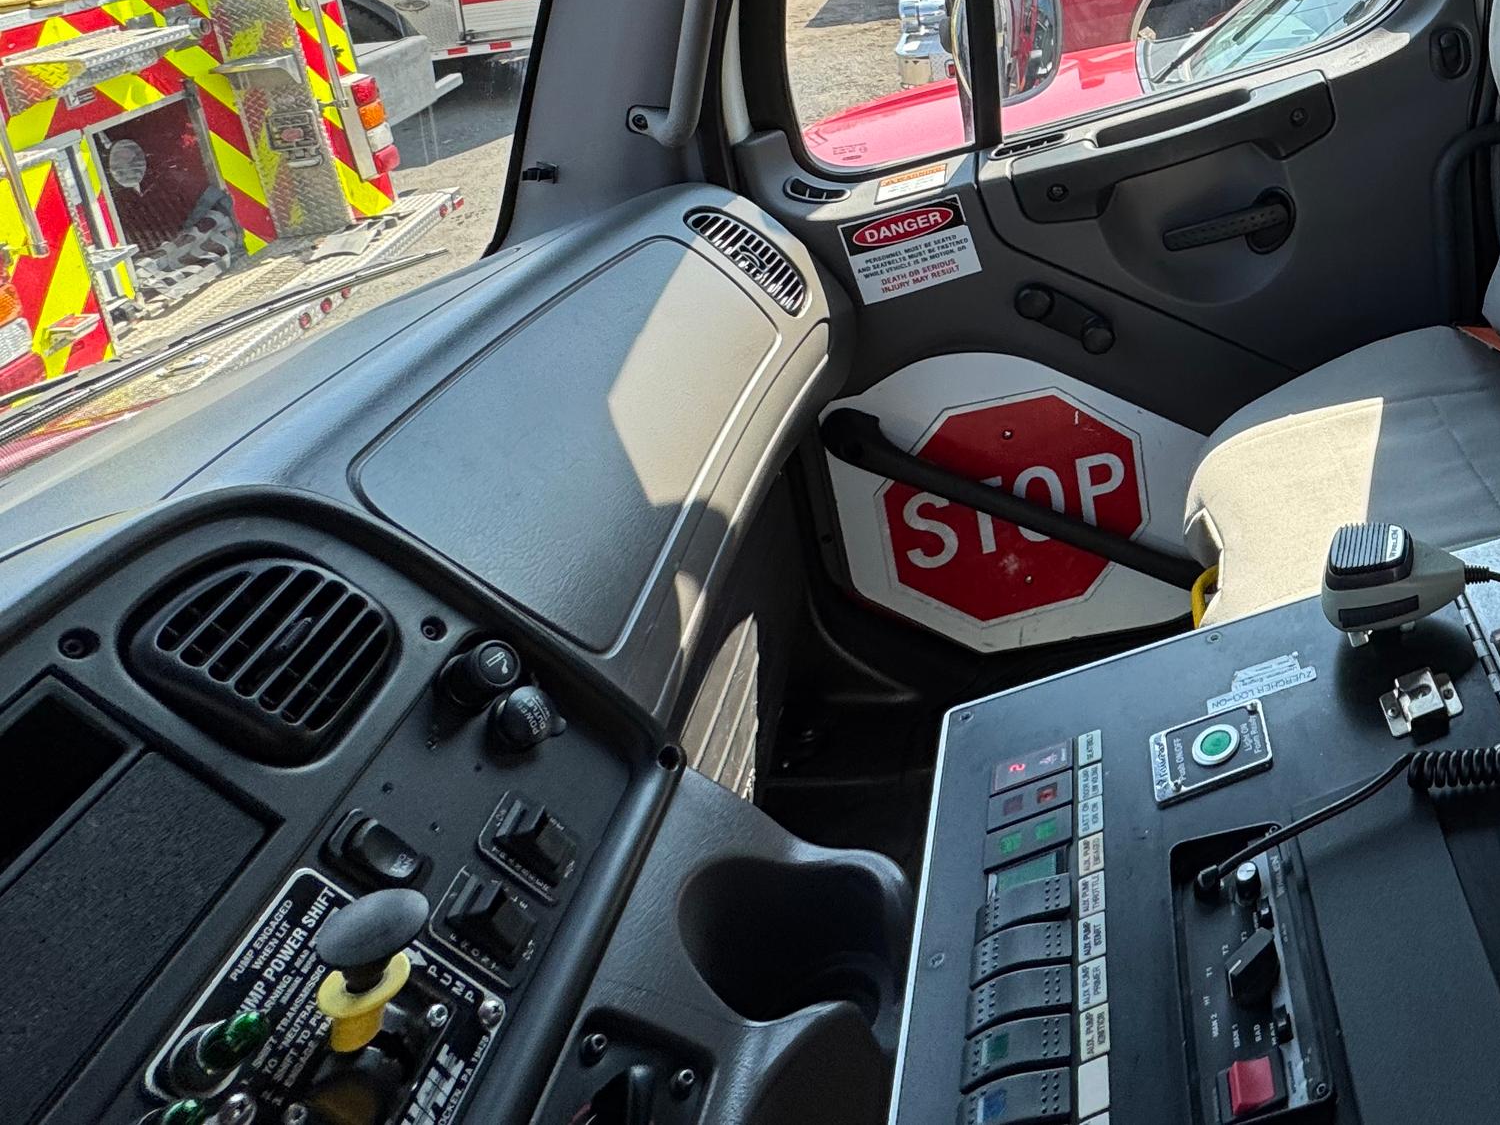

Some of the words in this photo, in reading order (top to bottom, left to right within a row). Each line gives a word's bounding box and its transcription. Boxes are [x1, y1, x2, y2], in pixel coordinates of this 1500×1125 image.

[864, 212, 943, 243] DANGER
[858, 266, 871, 274] AND
[873, 257, 906, 270] SEATBELTS
[908, 250, 926, 259] MUST
[938, 238, 969, 251] FASTENED
[865, 251, 902, 264] PERSONNEL
[905, 245, 922, 254] MUST
[933, 235, 957, 245] SEATED
[864, 269, 885, 279] WHILE
[886, 263, 912, 273] VEHICLE
[881, 273, 907, 285] DEATH
[910, 269, 920, 278] OR
[923, 258, 956, 273] SERIOUS
[881, 281, 910, 293] INJURY
[913, 276, 928, 287] MAY
[931, 265, 960, 279] RESULT
[1258, 670, 1312, 694] ZUERCHER
[518, 701, 540, 735] POWER
[524, 696, 546, 729] OUTLET
[229, 947, 258, 981] PUMP
[252, 897, 293, 950] ENGAGED
[252, 937, 279, 970] WHEN
[275, 919, 292, 938] LIT
[1083, 922, 1091, 942] PUMP
[236, 979, 270, 1018] UMP
[262, 925, 308, 982] POWER
[300, 885, 337, 928] SHIFT
[1222, 944, 1229, 956] T2
[427, 963, 479, 1004] PUMP
[1206, 966, 1212, 977] T1
[259, 973, 293, 1015] ARNING
[275, 962, 326, 1033] TRANSMISSIO
[296, 1027, 312, 1046] TO
[1085, 1012, 1093, 1035] PUMP
[262, 1056, 278, 1075] TO
[460, 1065, 474, 1082] PA
